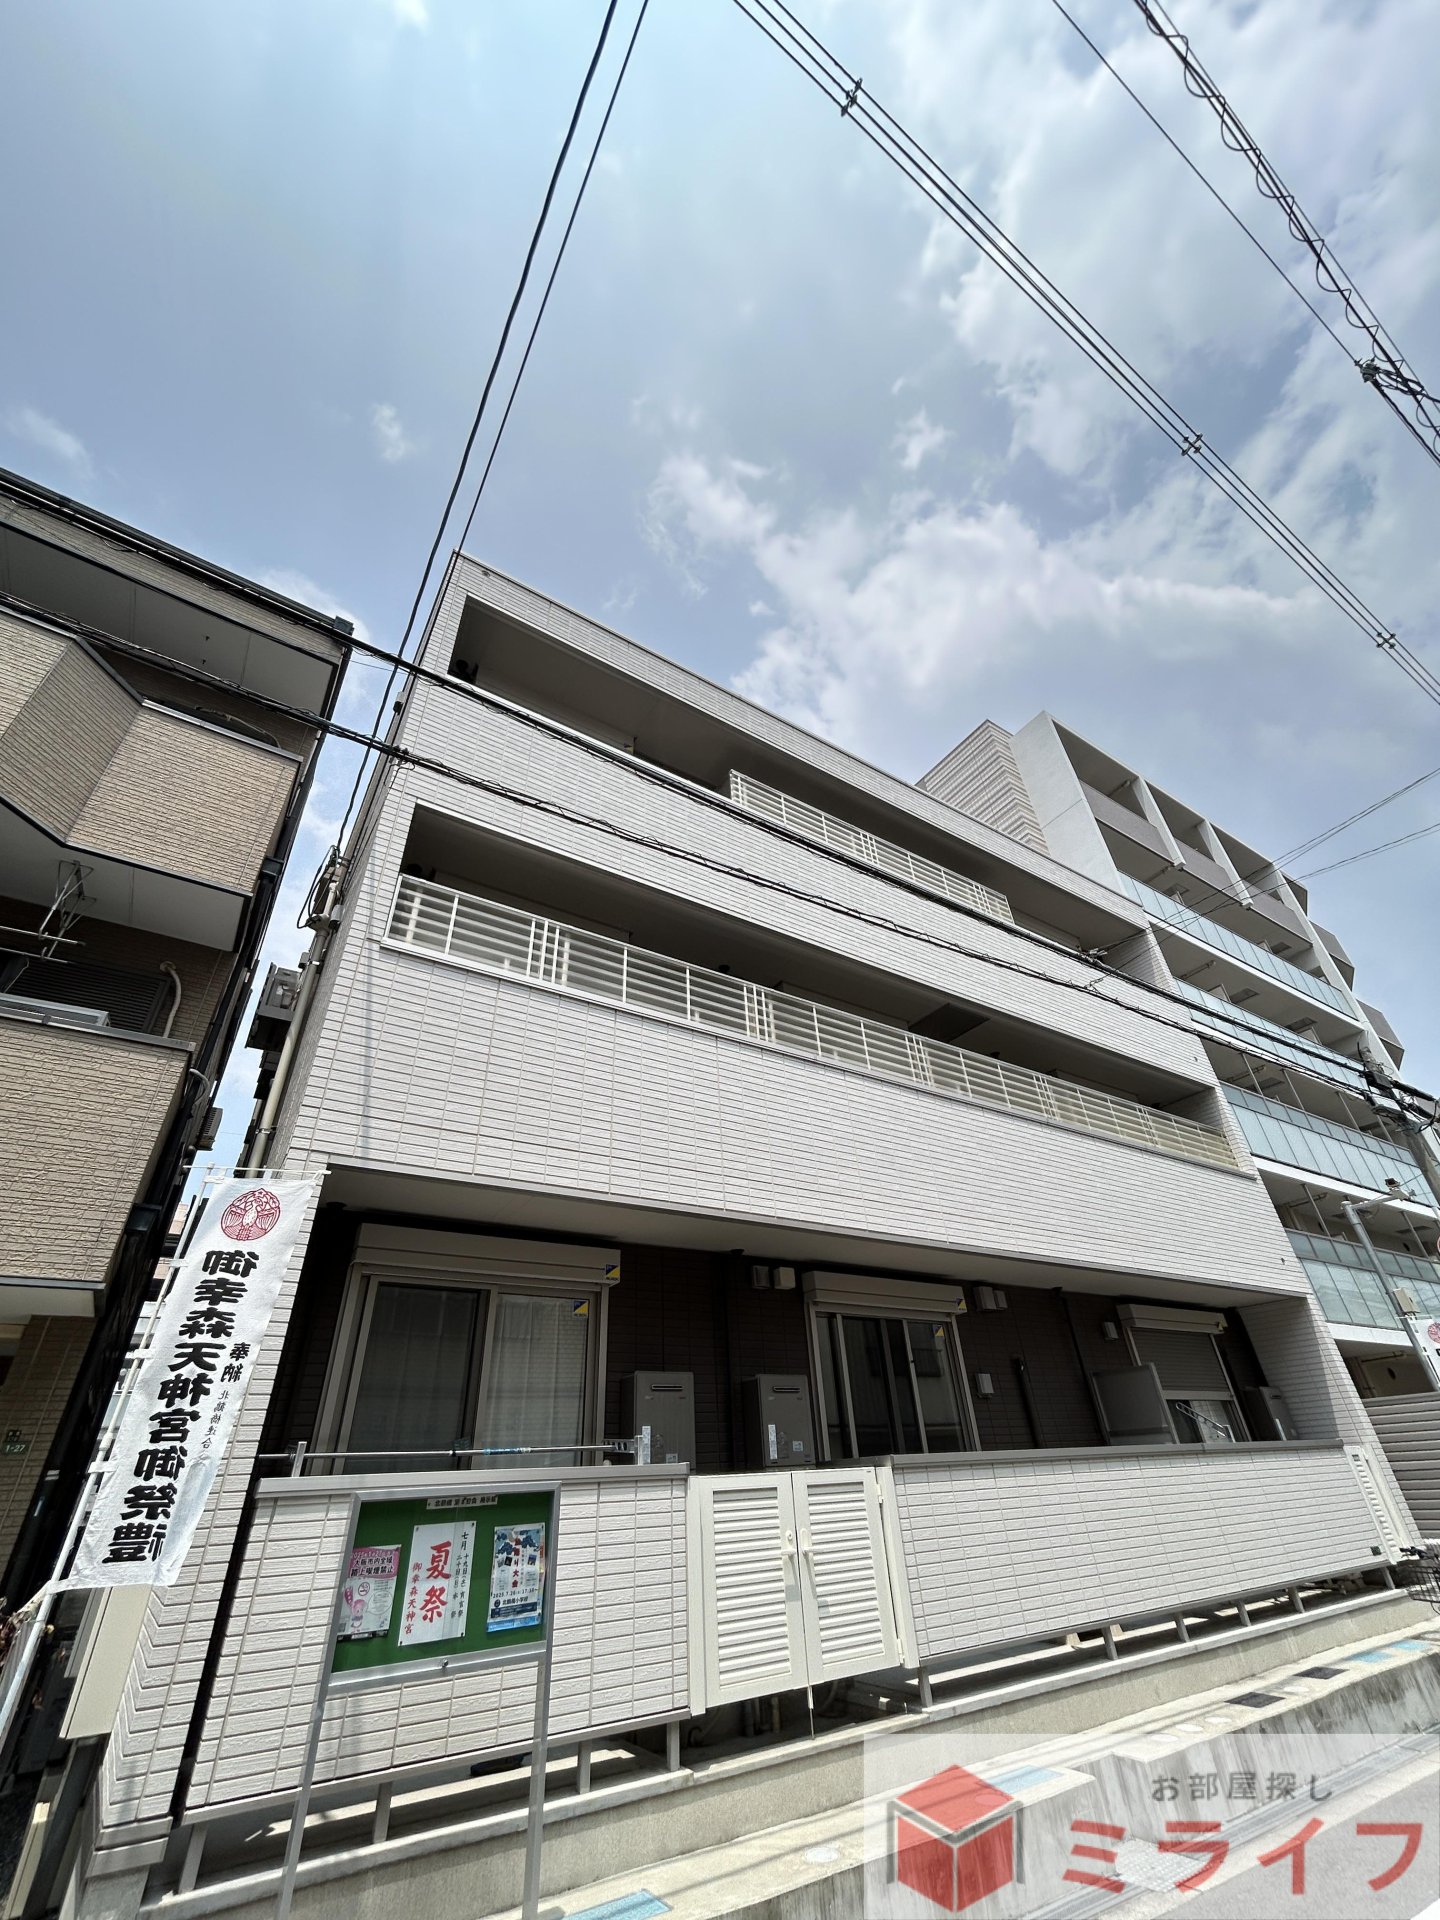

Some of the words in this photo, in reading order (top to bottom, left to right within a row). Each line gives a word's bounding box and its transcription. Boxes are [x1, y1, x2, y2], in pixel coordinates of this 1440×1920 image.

[6, 1444, 26, 1453] 1-27
[461, 1531, 470, 1550] 七月
[353, 1556, 393, 1566] 大阪市内全域
[350, 1565, 394, 1577] 路上喫煙禁止
[420, 1540, 452, 1623] 夏祭
[404, 1562, 422, 1635] 御幸森天神宮
